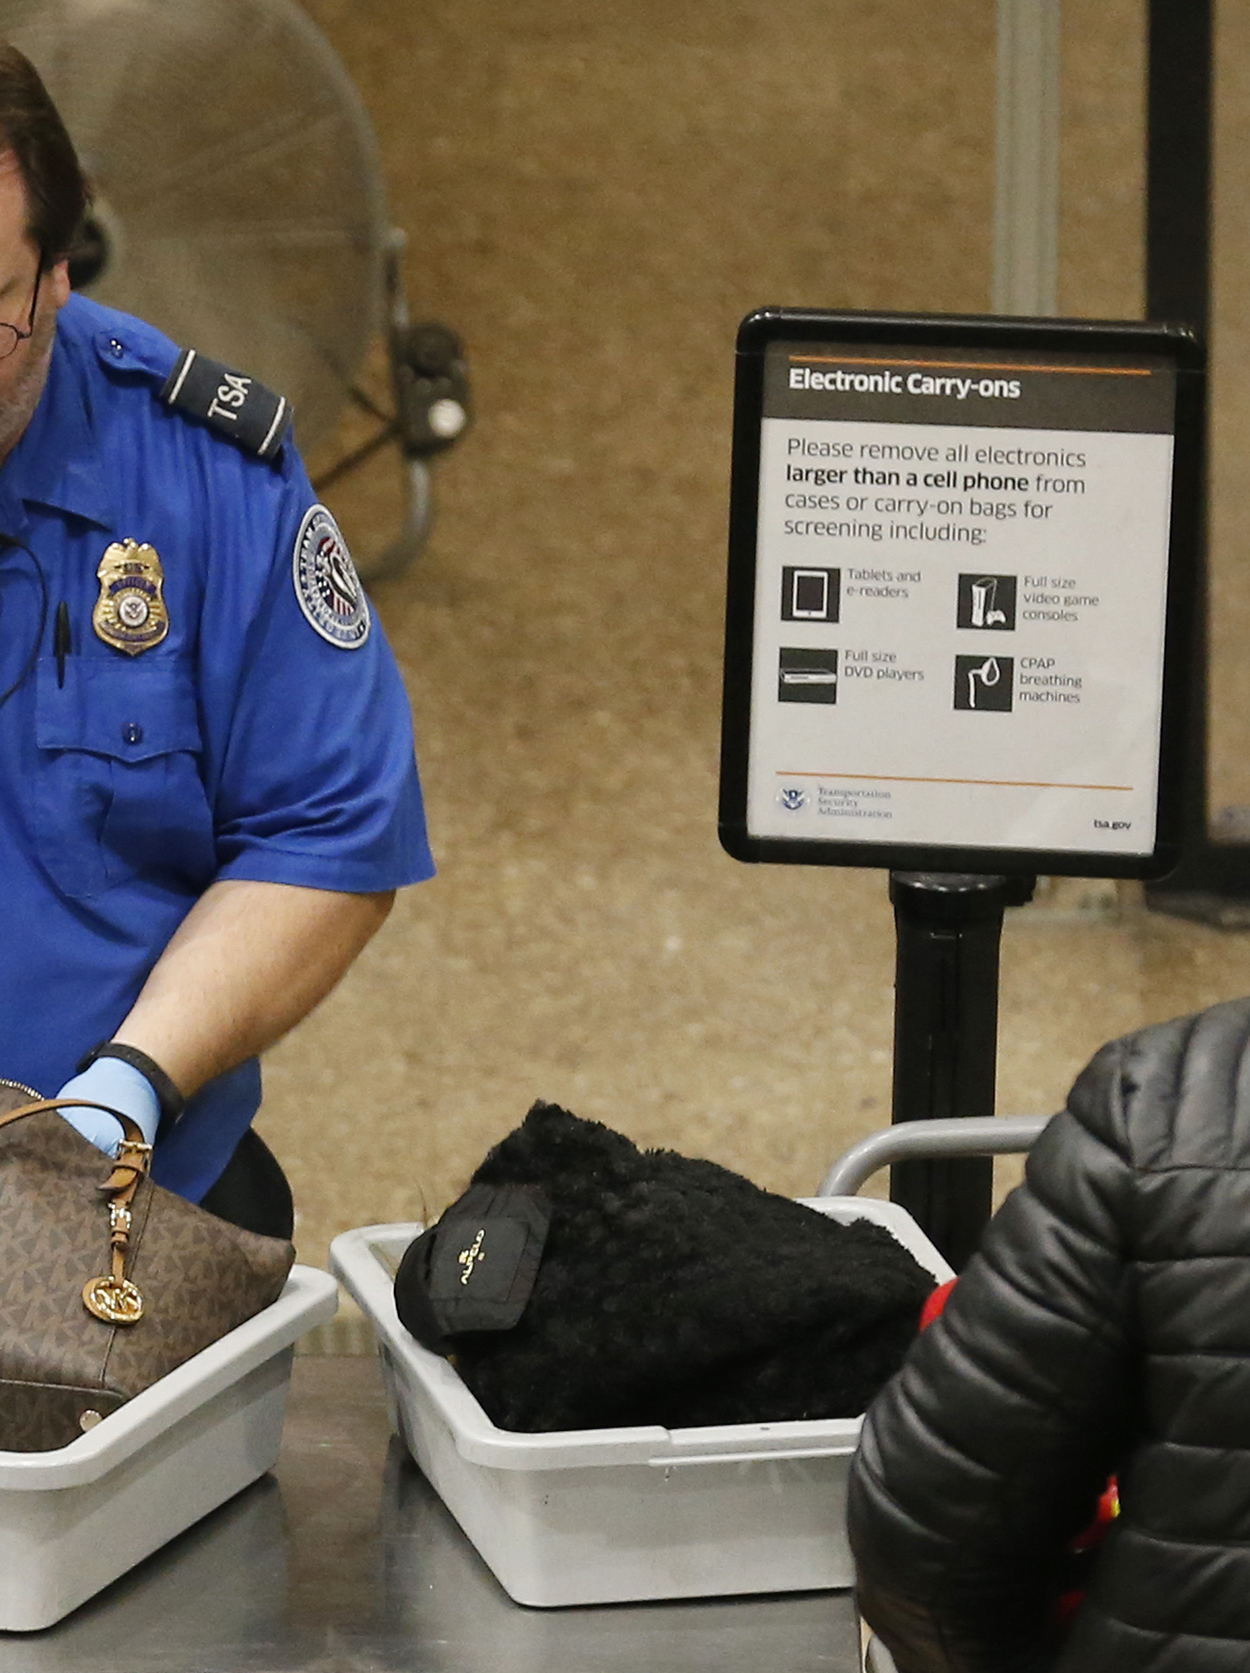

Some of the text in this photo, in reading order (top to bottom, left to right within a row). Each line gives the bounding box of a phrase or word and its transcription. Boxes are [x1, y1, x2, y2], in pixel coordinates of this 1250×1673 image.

[789, 368, 1020, 399] Electronic Carry-ons
[207, 373, 252, 421] TSA
[787, 438, 1086, 468] Please remove all electronics
[786, 464, 1085, 493] larger than a cell phone from
[785, 493, 1052, 520] cases or carry-on bags for
[785, 520, 987, 545] screening including:
[848, 568, 921, 583] Tablets and
[1025, 575, 1076, 590] Full size
[847, 585, 909, 599] e-readers
[1024, 592, 1099, 607] video game
[1022, 608, 1078, 622] consoles
[845, 650, 896, 664] Full size
[1020, 657, 1056, 670] CPAP
[844, 666, 924, 682] DVD players
[1020, 673, 1082, 689] breathing
[1019, 689, 1080, 703] machines
[818, 787, 891, 799] Transportation
[818, 797, 858, 808] Security
[818, 807, 892, 819] Administration
[1094, 818, 1131, 831] tsa.gov
